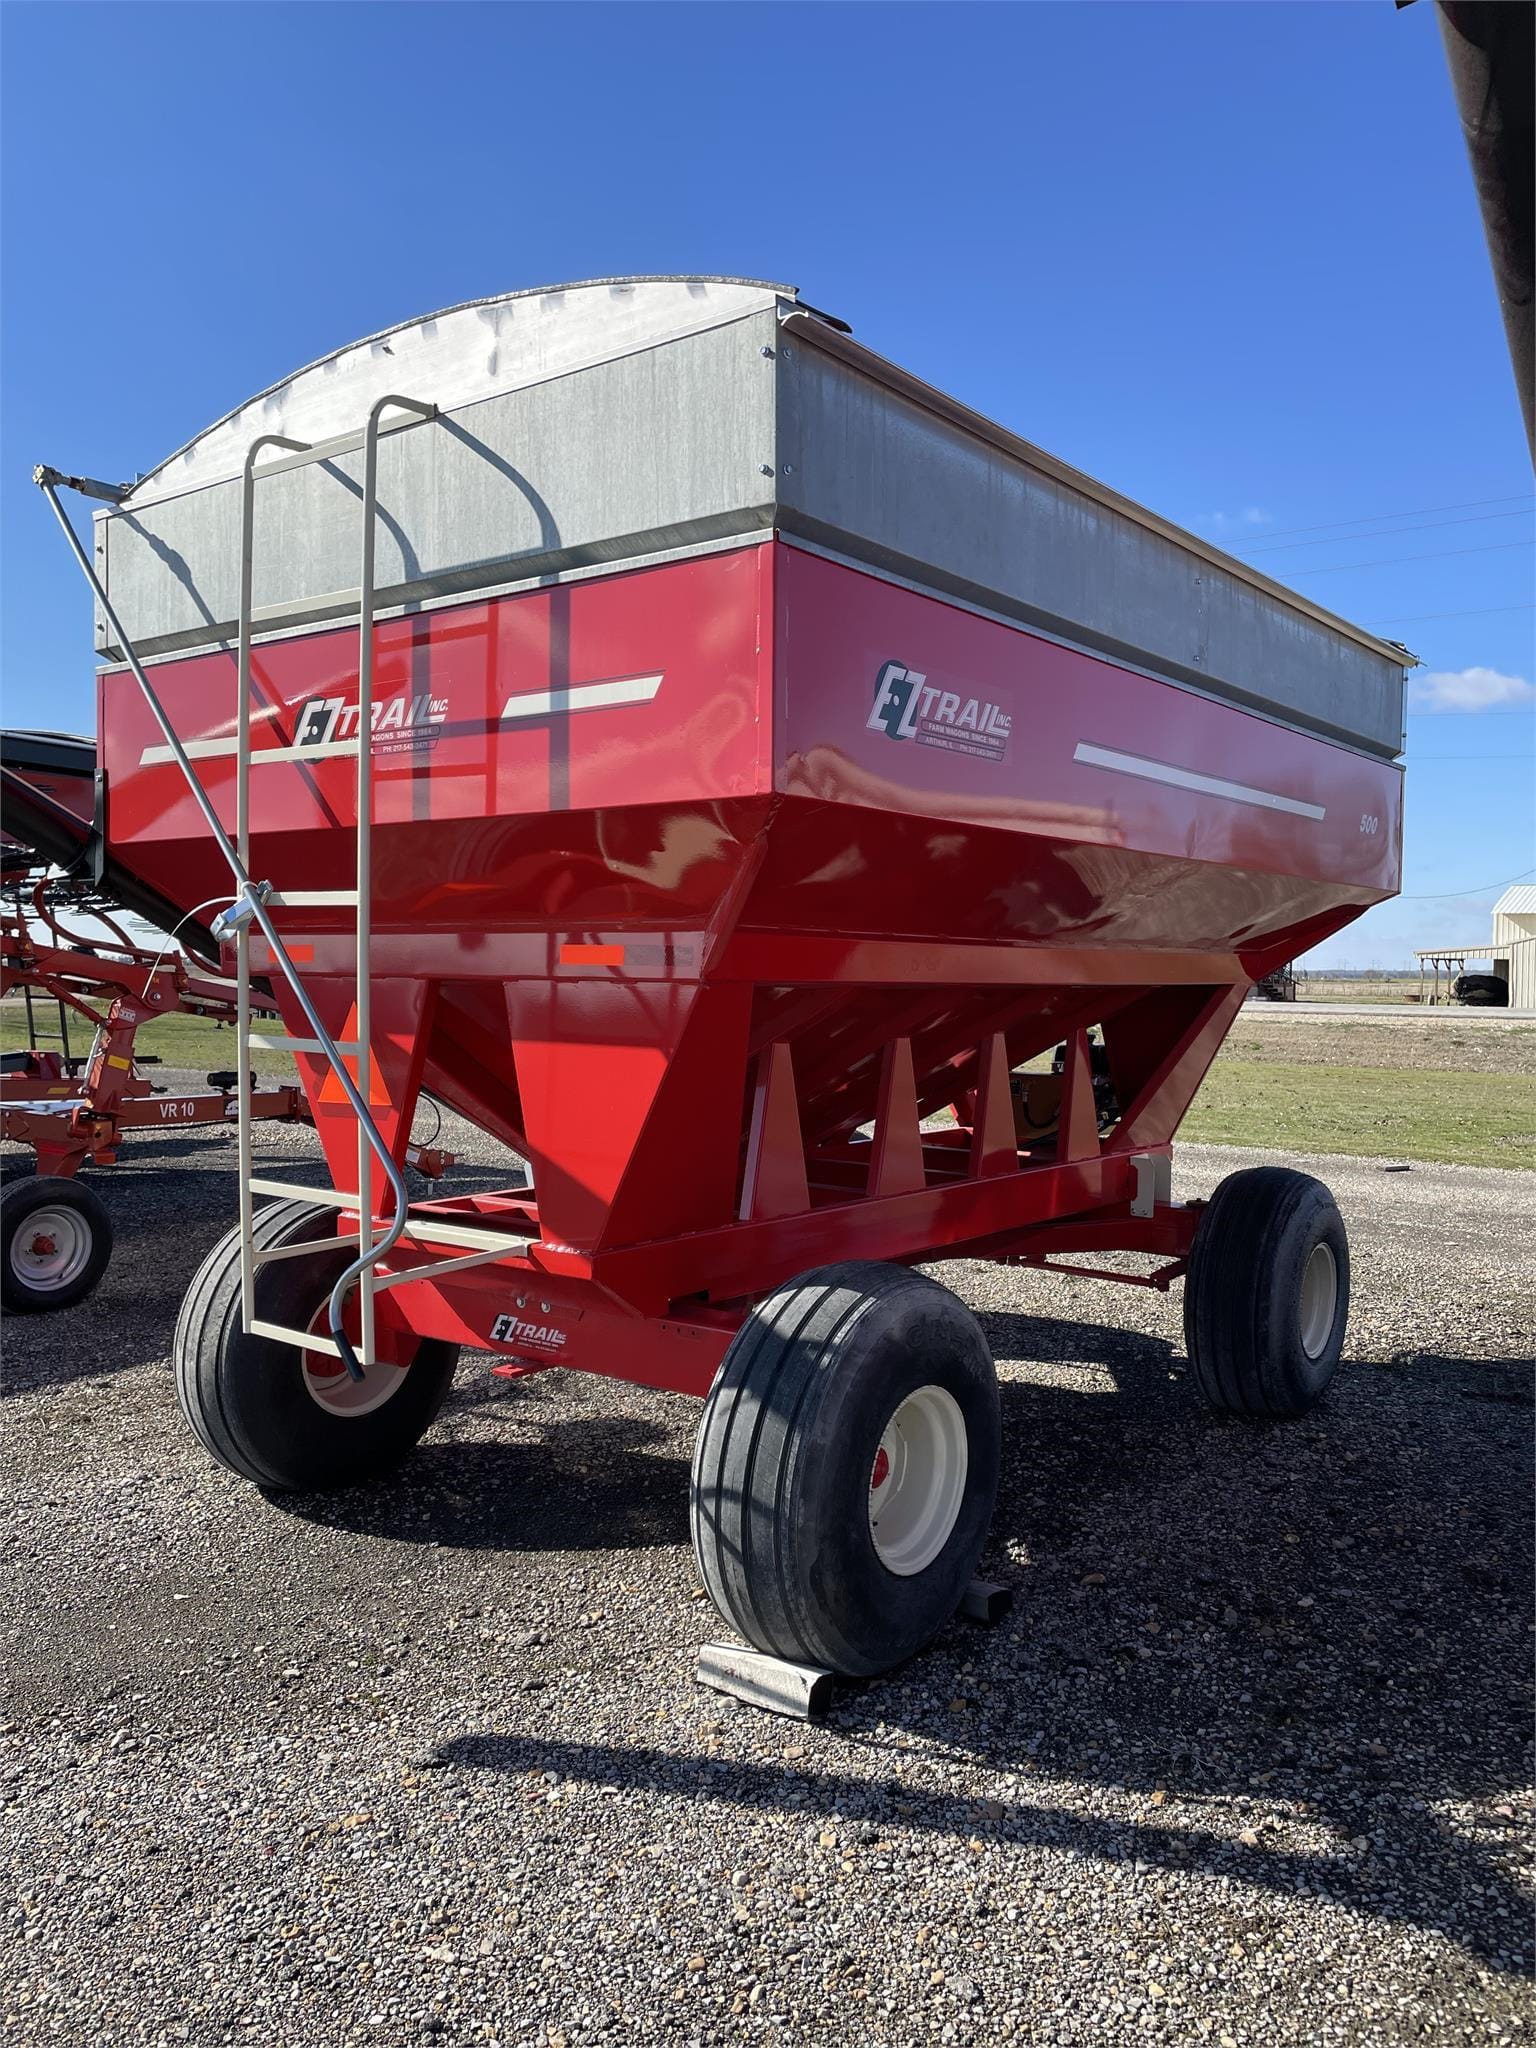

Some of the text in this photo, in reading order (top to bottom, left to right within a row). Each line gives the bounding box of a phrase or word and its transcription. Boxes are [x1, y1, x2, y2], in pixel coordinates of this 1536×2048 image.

[429, 699, 449, 713] INC.
[866, 664, 927, 738] EZ
[920, 686, 1009, 737] TRAIL
[371, 732, 394, 742] AGONS
[397, 729, 416, 739] SINCE
[971, 733, 987, 744] SINCE
[1360, 814, 1378, 835] 500
[160, 1102, 195, 1118] VR 10
[489, 1314, 518, 1343] EZ
[515, 1322, 566, 1344] TRAIL
